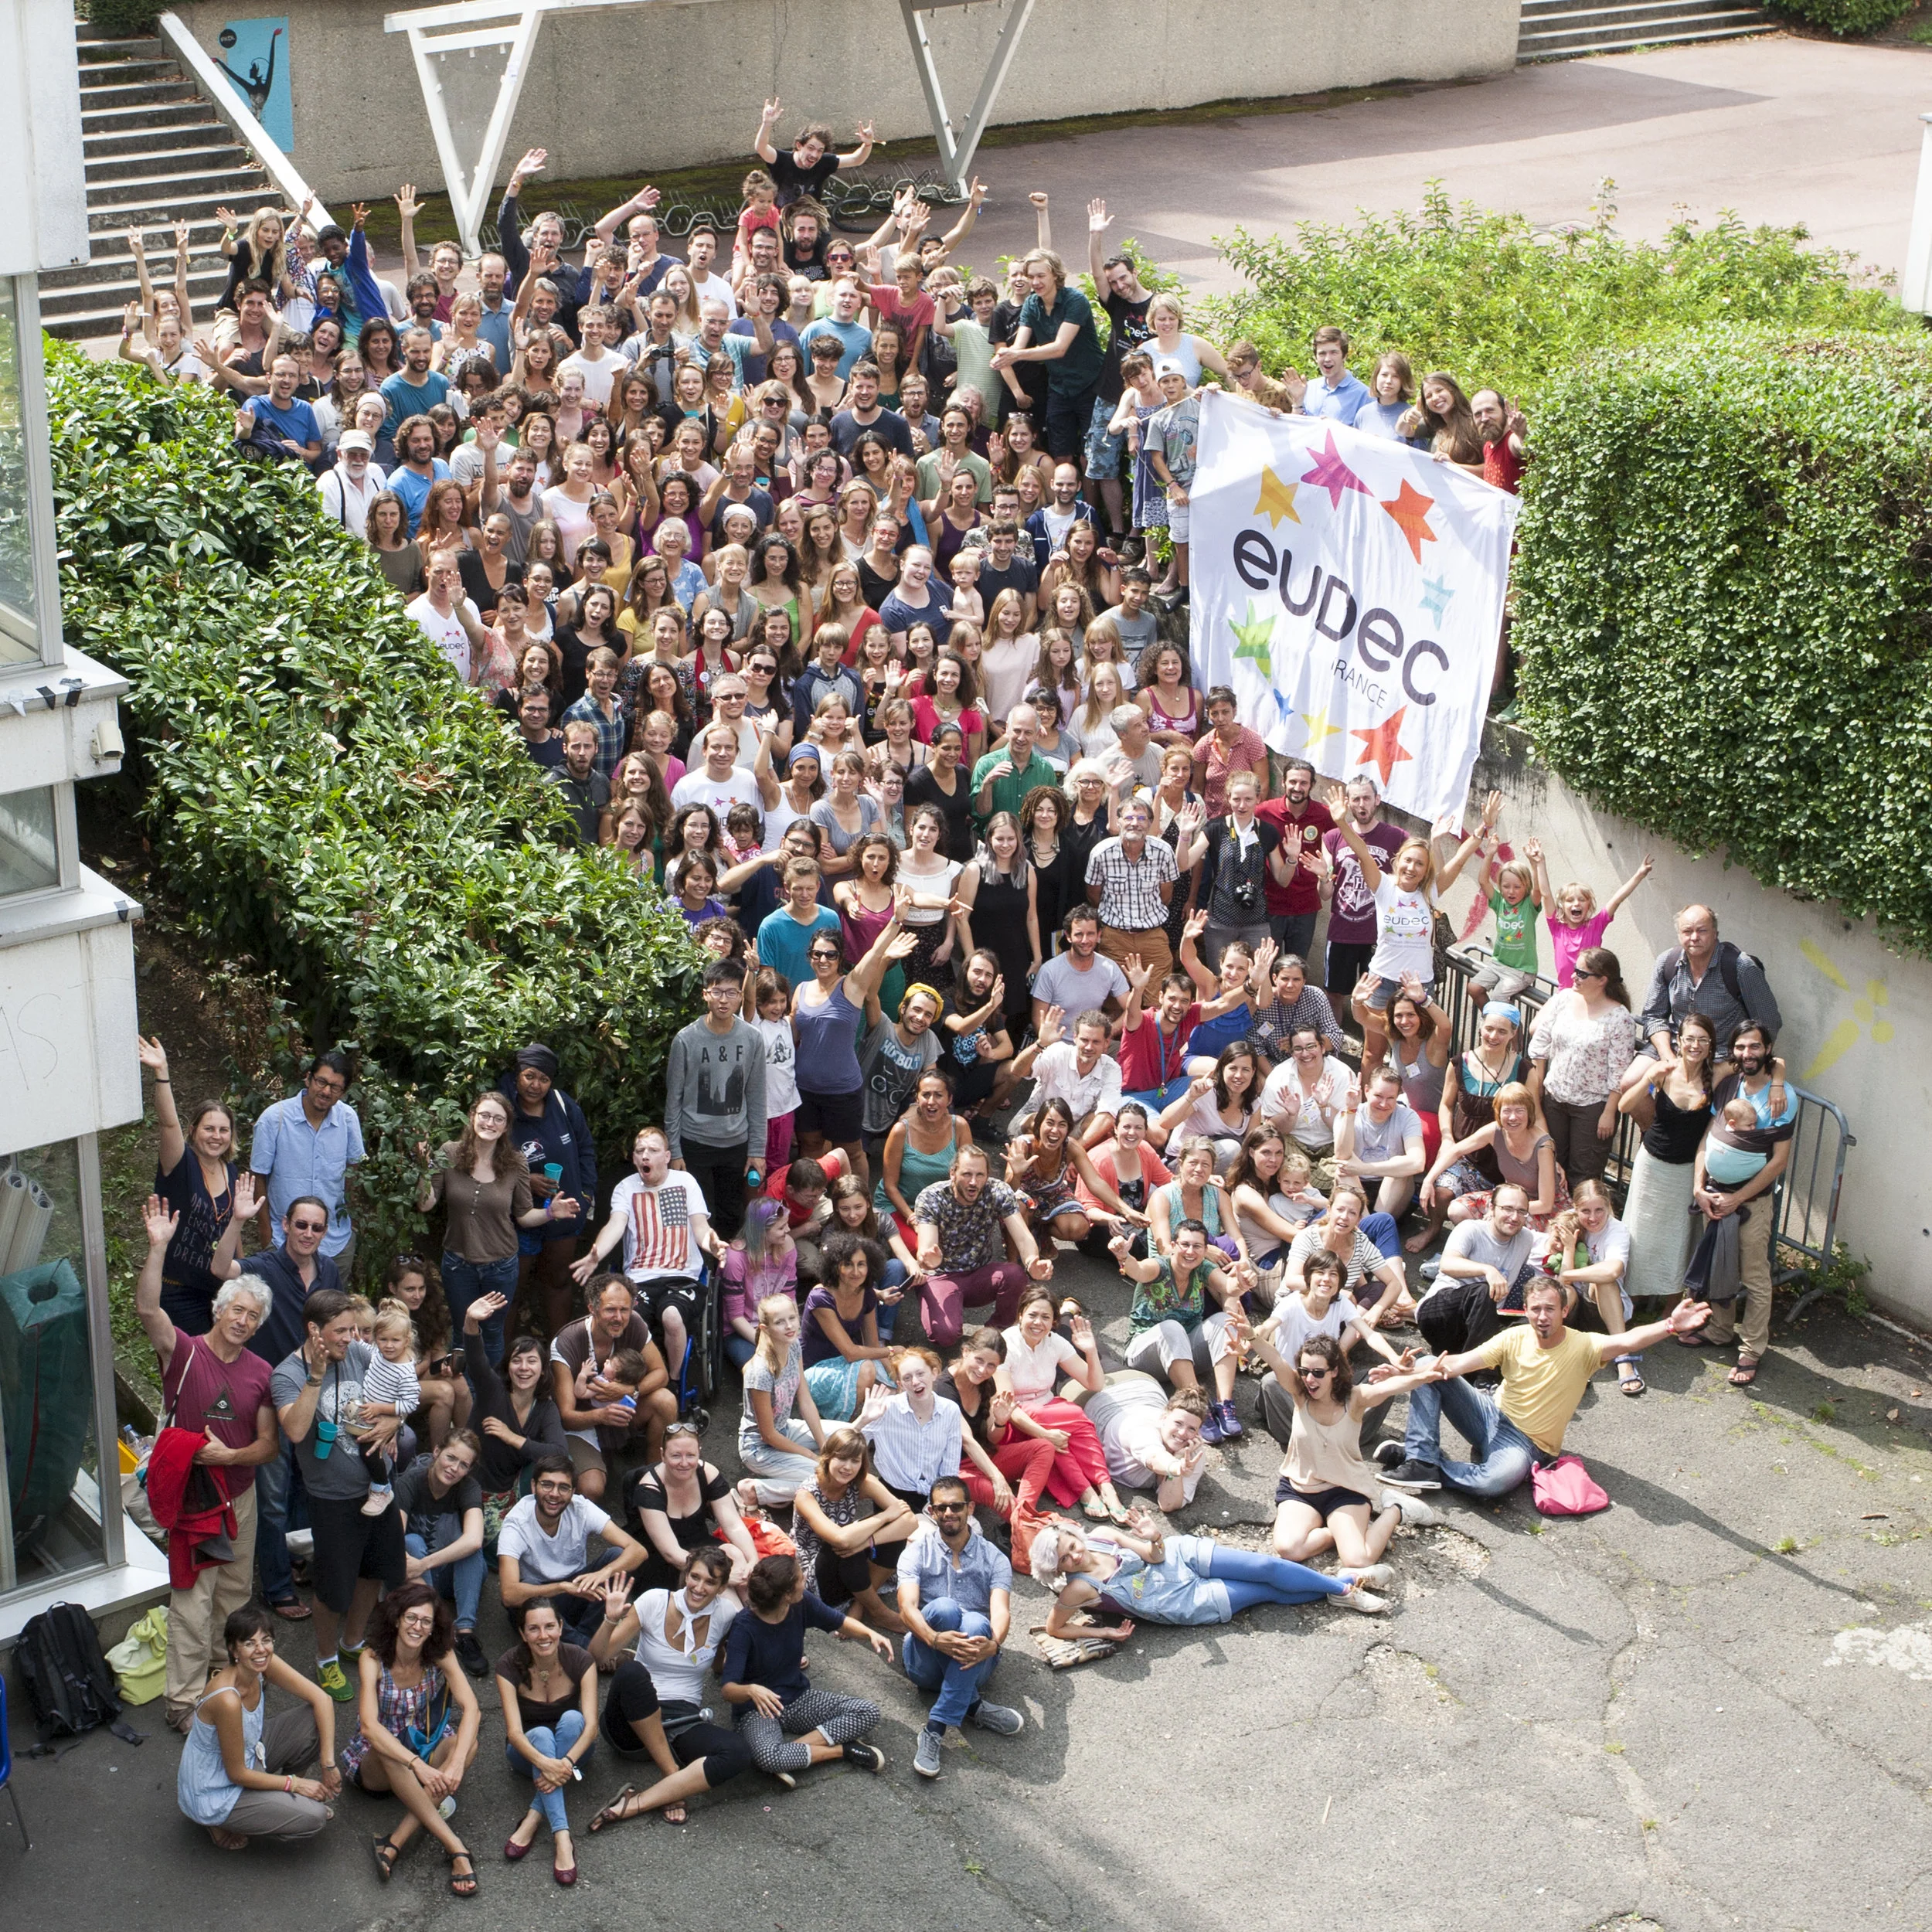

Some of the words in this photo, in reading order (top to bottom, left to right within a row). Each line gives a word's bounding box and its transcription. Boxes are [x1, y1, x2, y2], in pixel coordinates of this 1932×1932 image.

[1331, 657, 1388, 709] RANCE
[701, 1047, 710, 1063] A
[719, 1046, 728, 1063] &
[736, 1045, 743, 1062] F
[181, 1226, 199, 1247] BE
